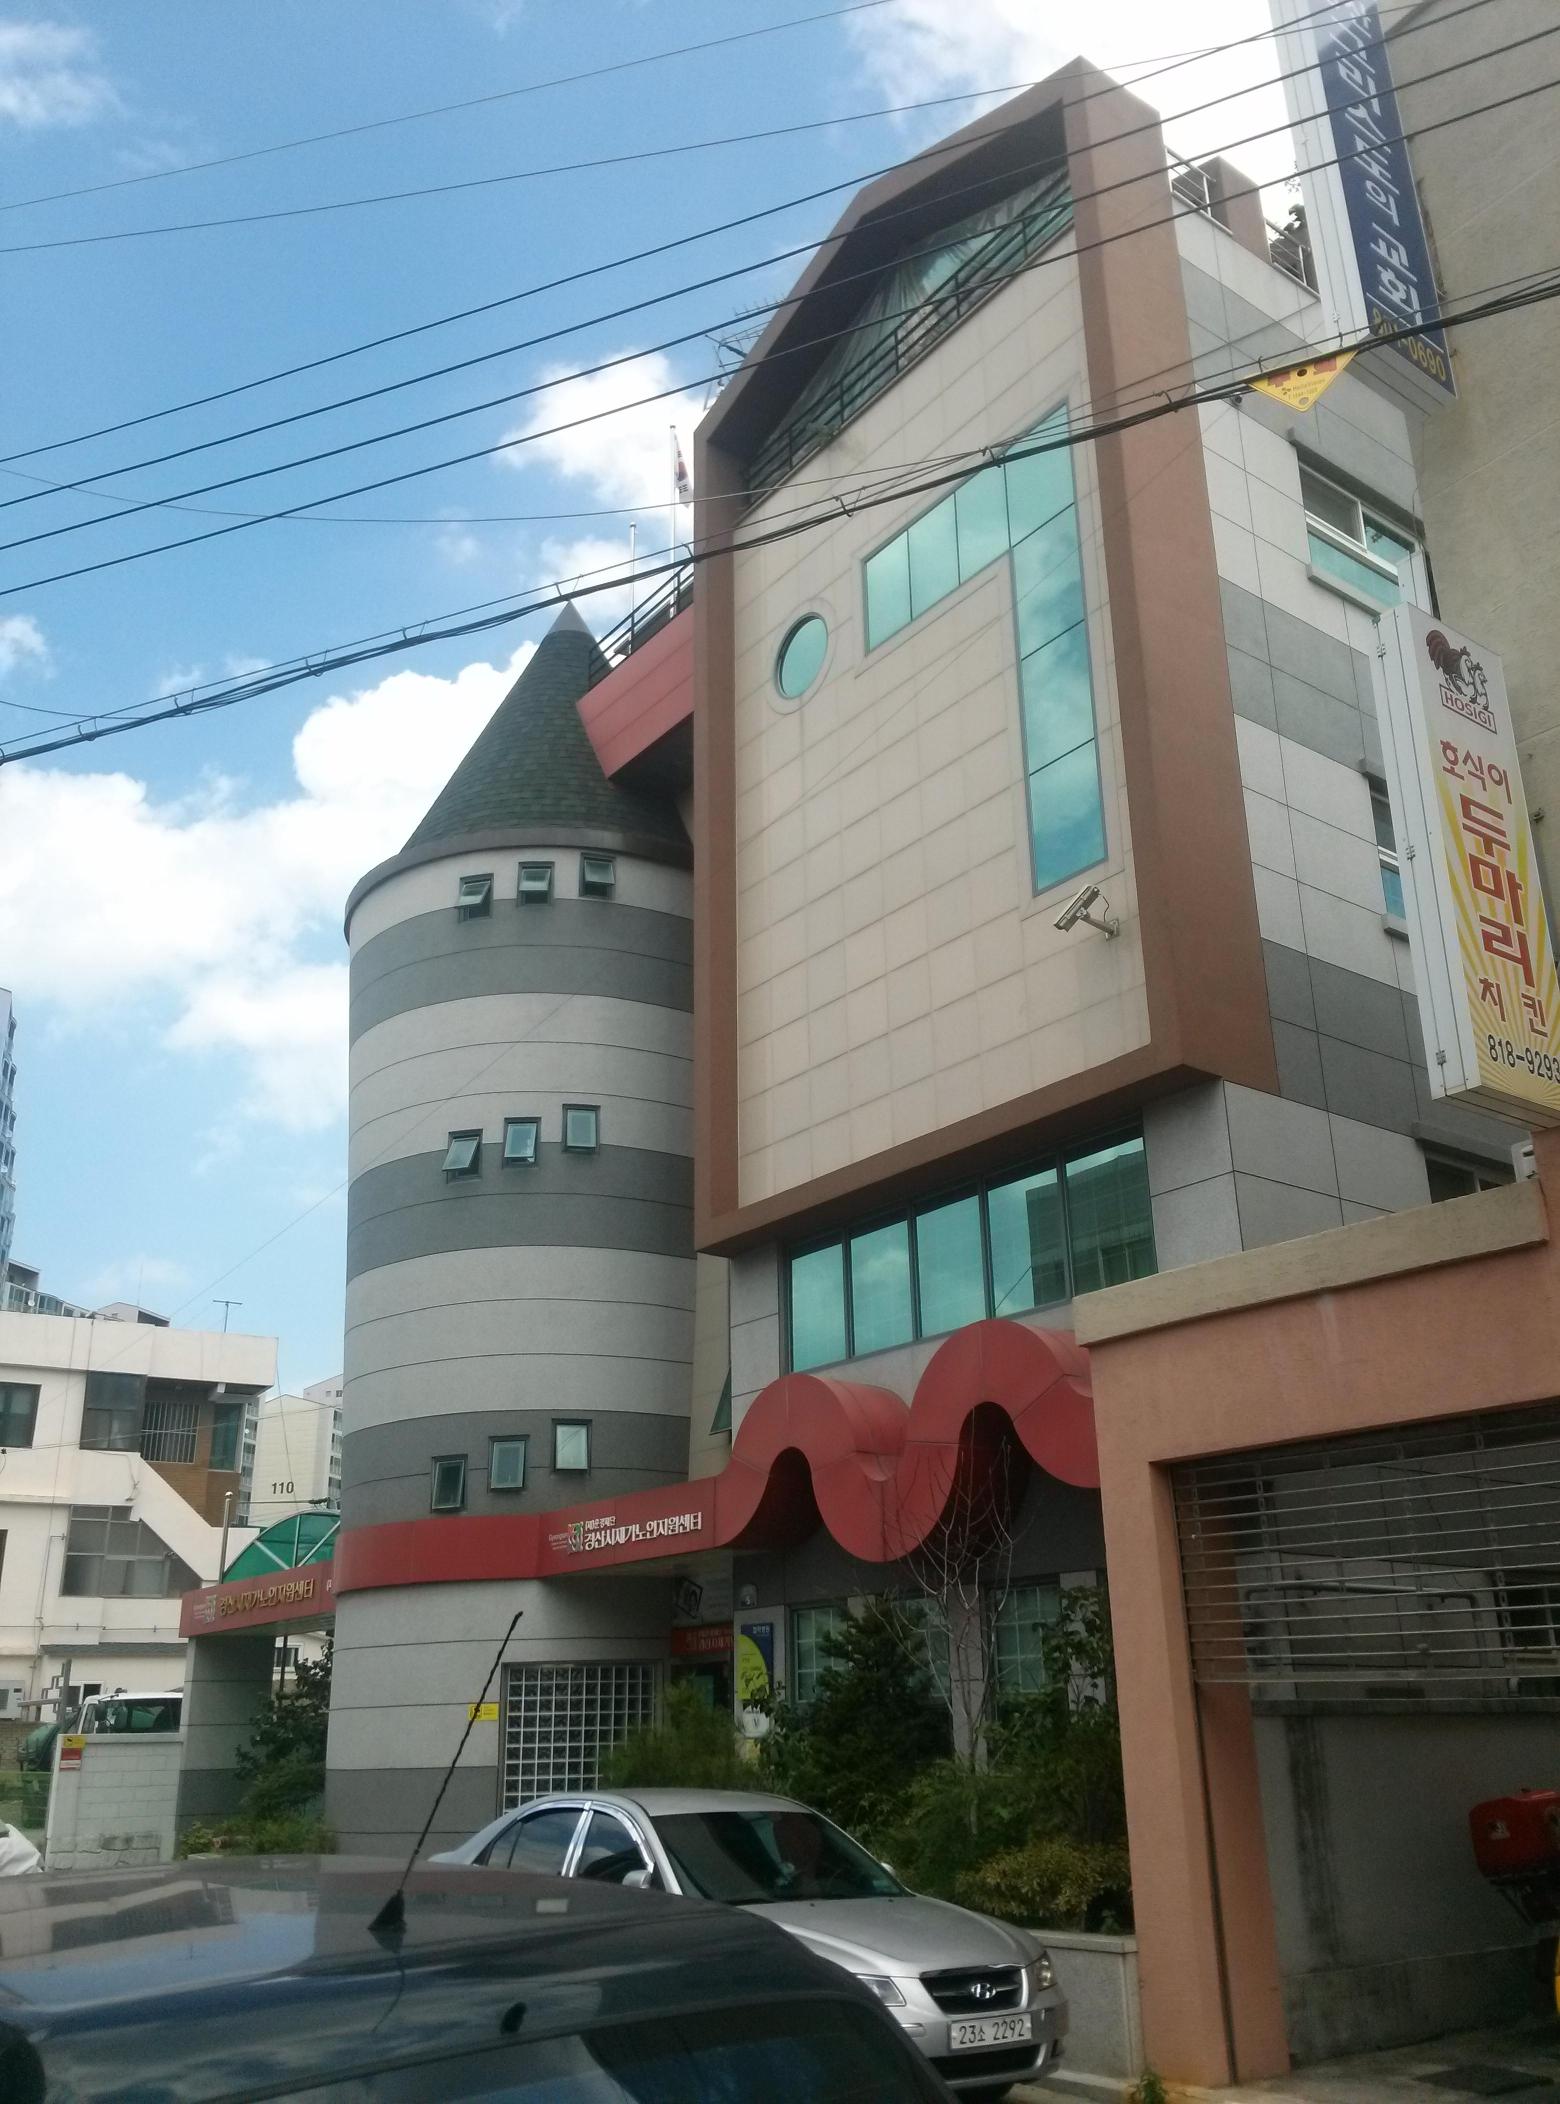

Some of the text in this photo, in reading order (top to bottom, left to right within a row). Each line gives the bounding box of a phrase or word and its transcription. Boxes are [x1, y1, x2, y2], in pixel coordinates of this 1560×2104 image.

[1443, 691, 1495, 728] HOSIGI
[1440, 739, 1512, 805] 호식이
[1460, 792, 1535, 988] 두마리
[1479, 977, 1548, 1037] 치킨
[1488, 1034, 1560, 1084] 818-9293
[272, 1481, 295, 1494] 110
[992, 2018, 1025, 2041] 2292
